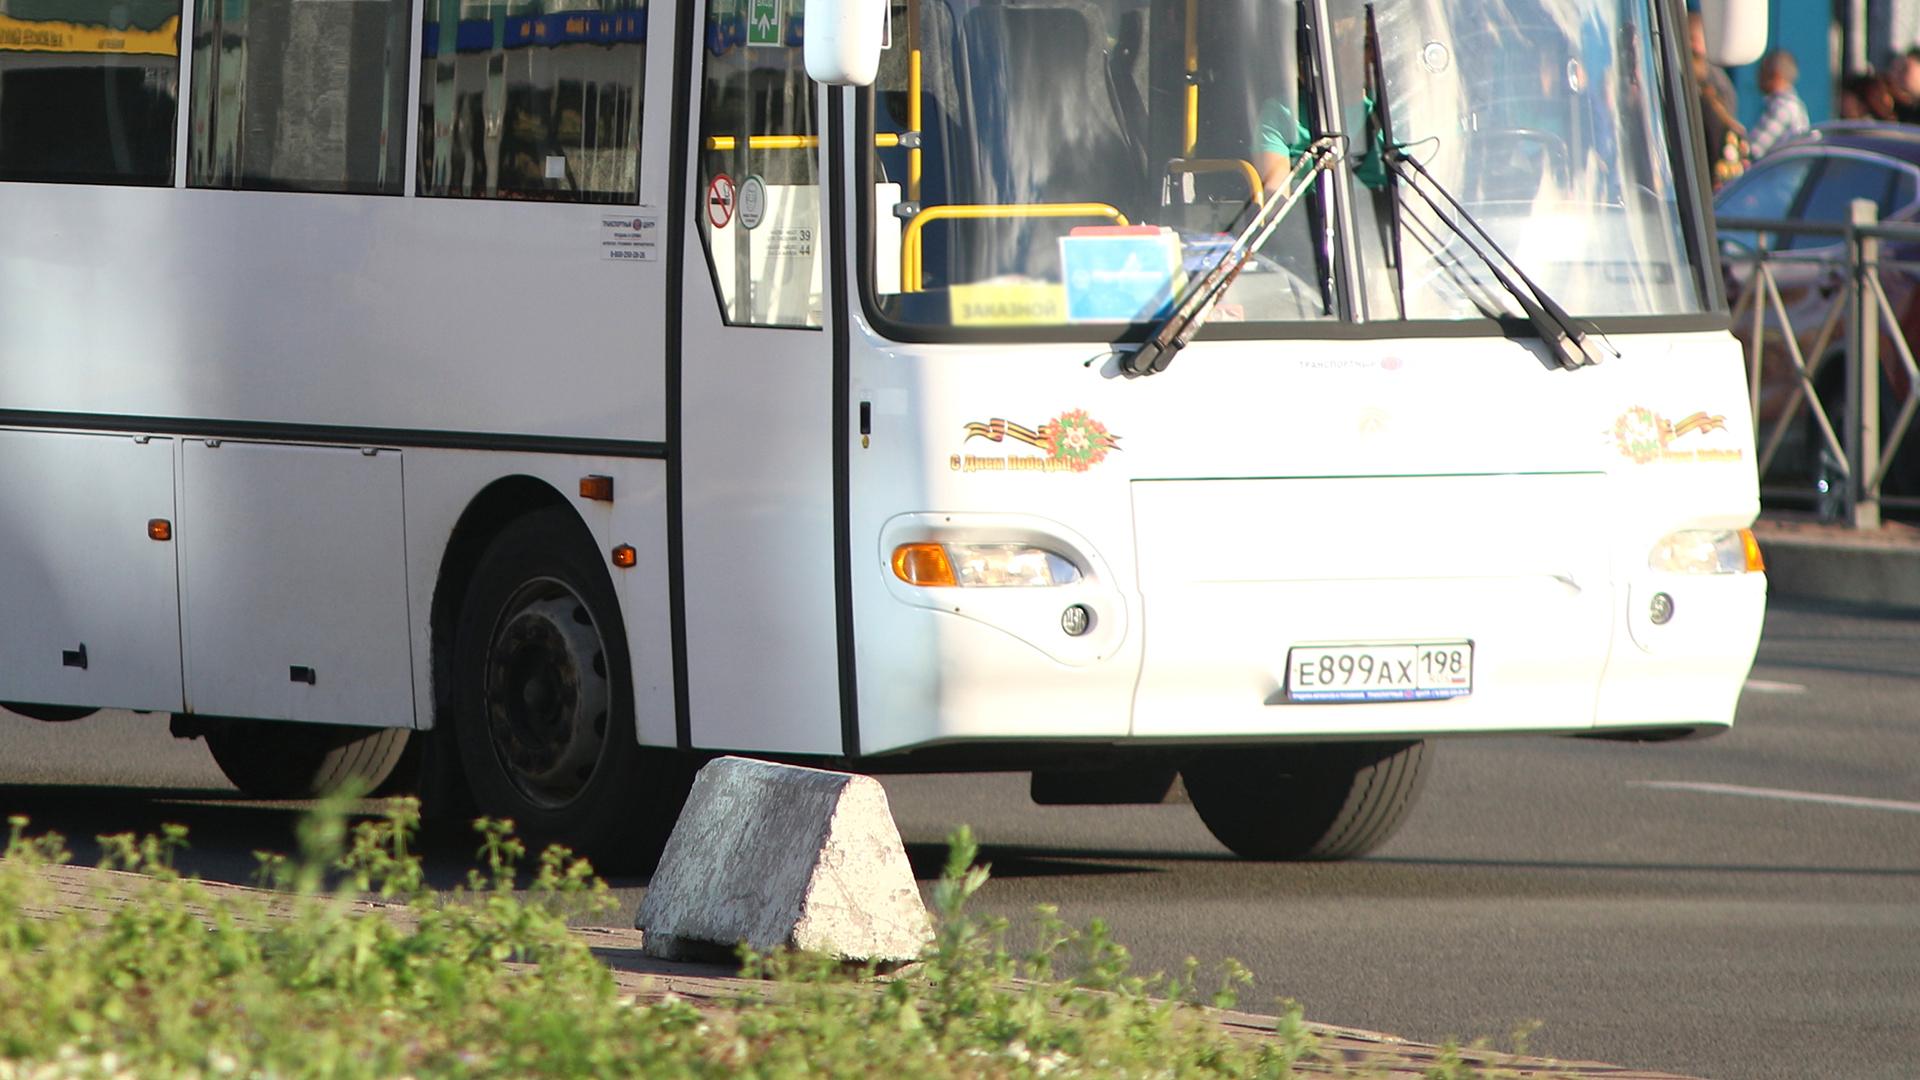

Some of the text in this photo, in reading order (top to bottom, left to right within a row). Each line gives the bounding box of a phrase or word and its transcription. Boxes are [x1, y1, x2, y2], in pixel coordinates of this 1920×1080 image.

[799, 230, 811, 241] 39
[799, 245, 811, 255] 44
[963, 300, 1057, 318] ЗАКАЗНОЙ
[1300, 650, 1463, 686] Е899АХ 198
